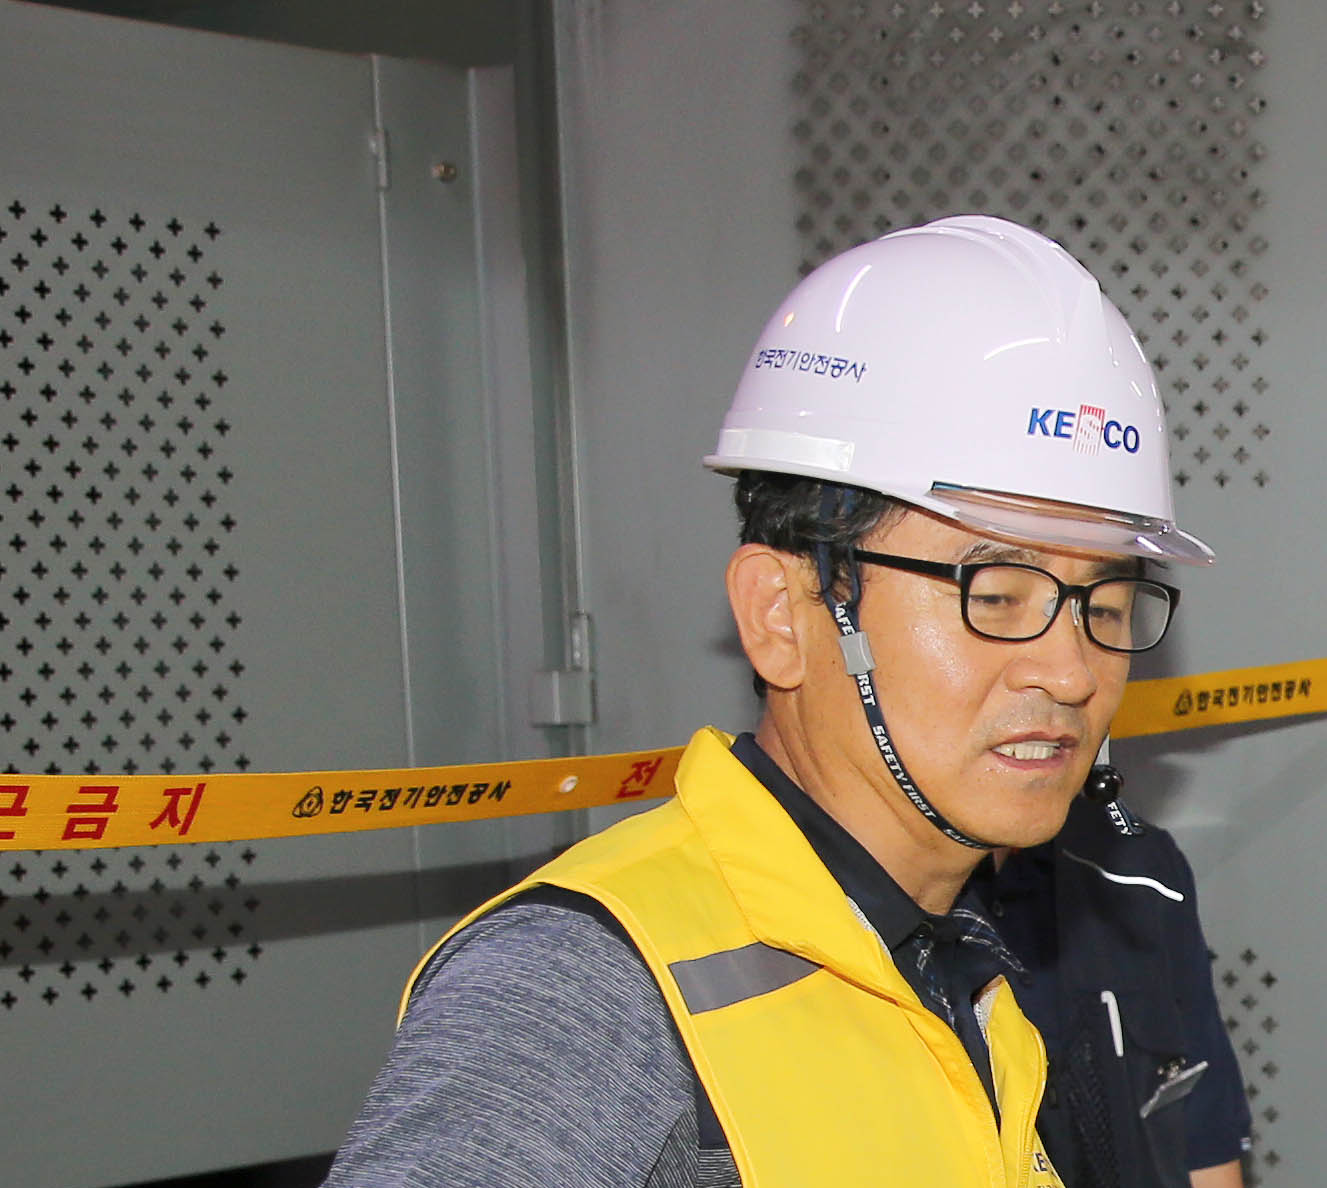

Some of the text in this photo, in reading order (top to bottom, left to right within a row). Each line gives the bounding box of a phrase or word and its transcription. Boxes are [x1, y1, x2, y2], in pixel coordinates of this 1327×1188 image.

[755, 348, 868, 383] 한국전기안전공사
[1026, 403, 1141, 456] KESCO
[872, 723, 938, 820] SAFETY FIRST
[328, 779, 512, 816] 한국전기안전공사
